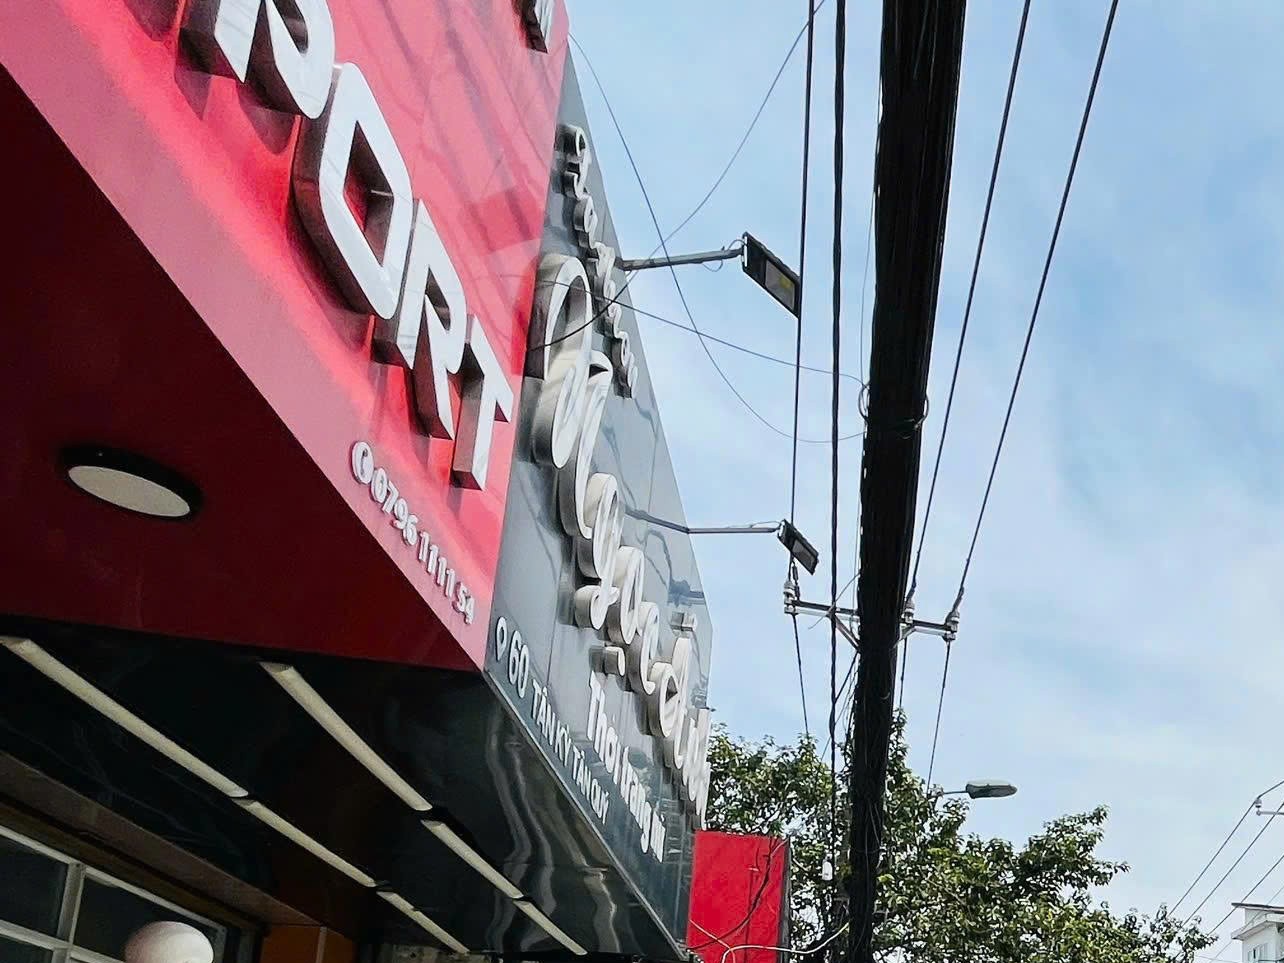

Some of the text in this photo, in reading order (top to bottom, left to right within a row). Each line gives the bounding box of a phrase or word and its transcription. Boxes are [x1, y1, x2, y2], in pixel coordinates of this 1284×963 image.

[541, 255, 660, 696] Ngọc
[507, 629, 530, 699] 60
[531, 679, 556, 746] TÂN
